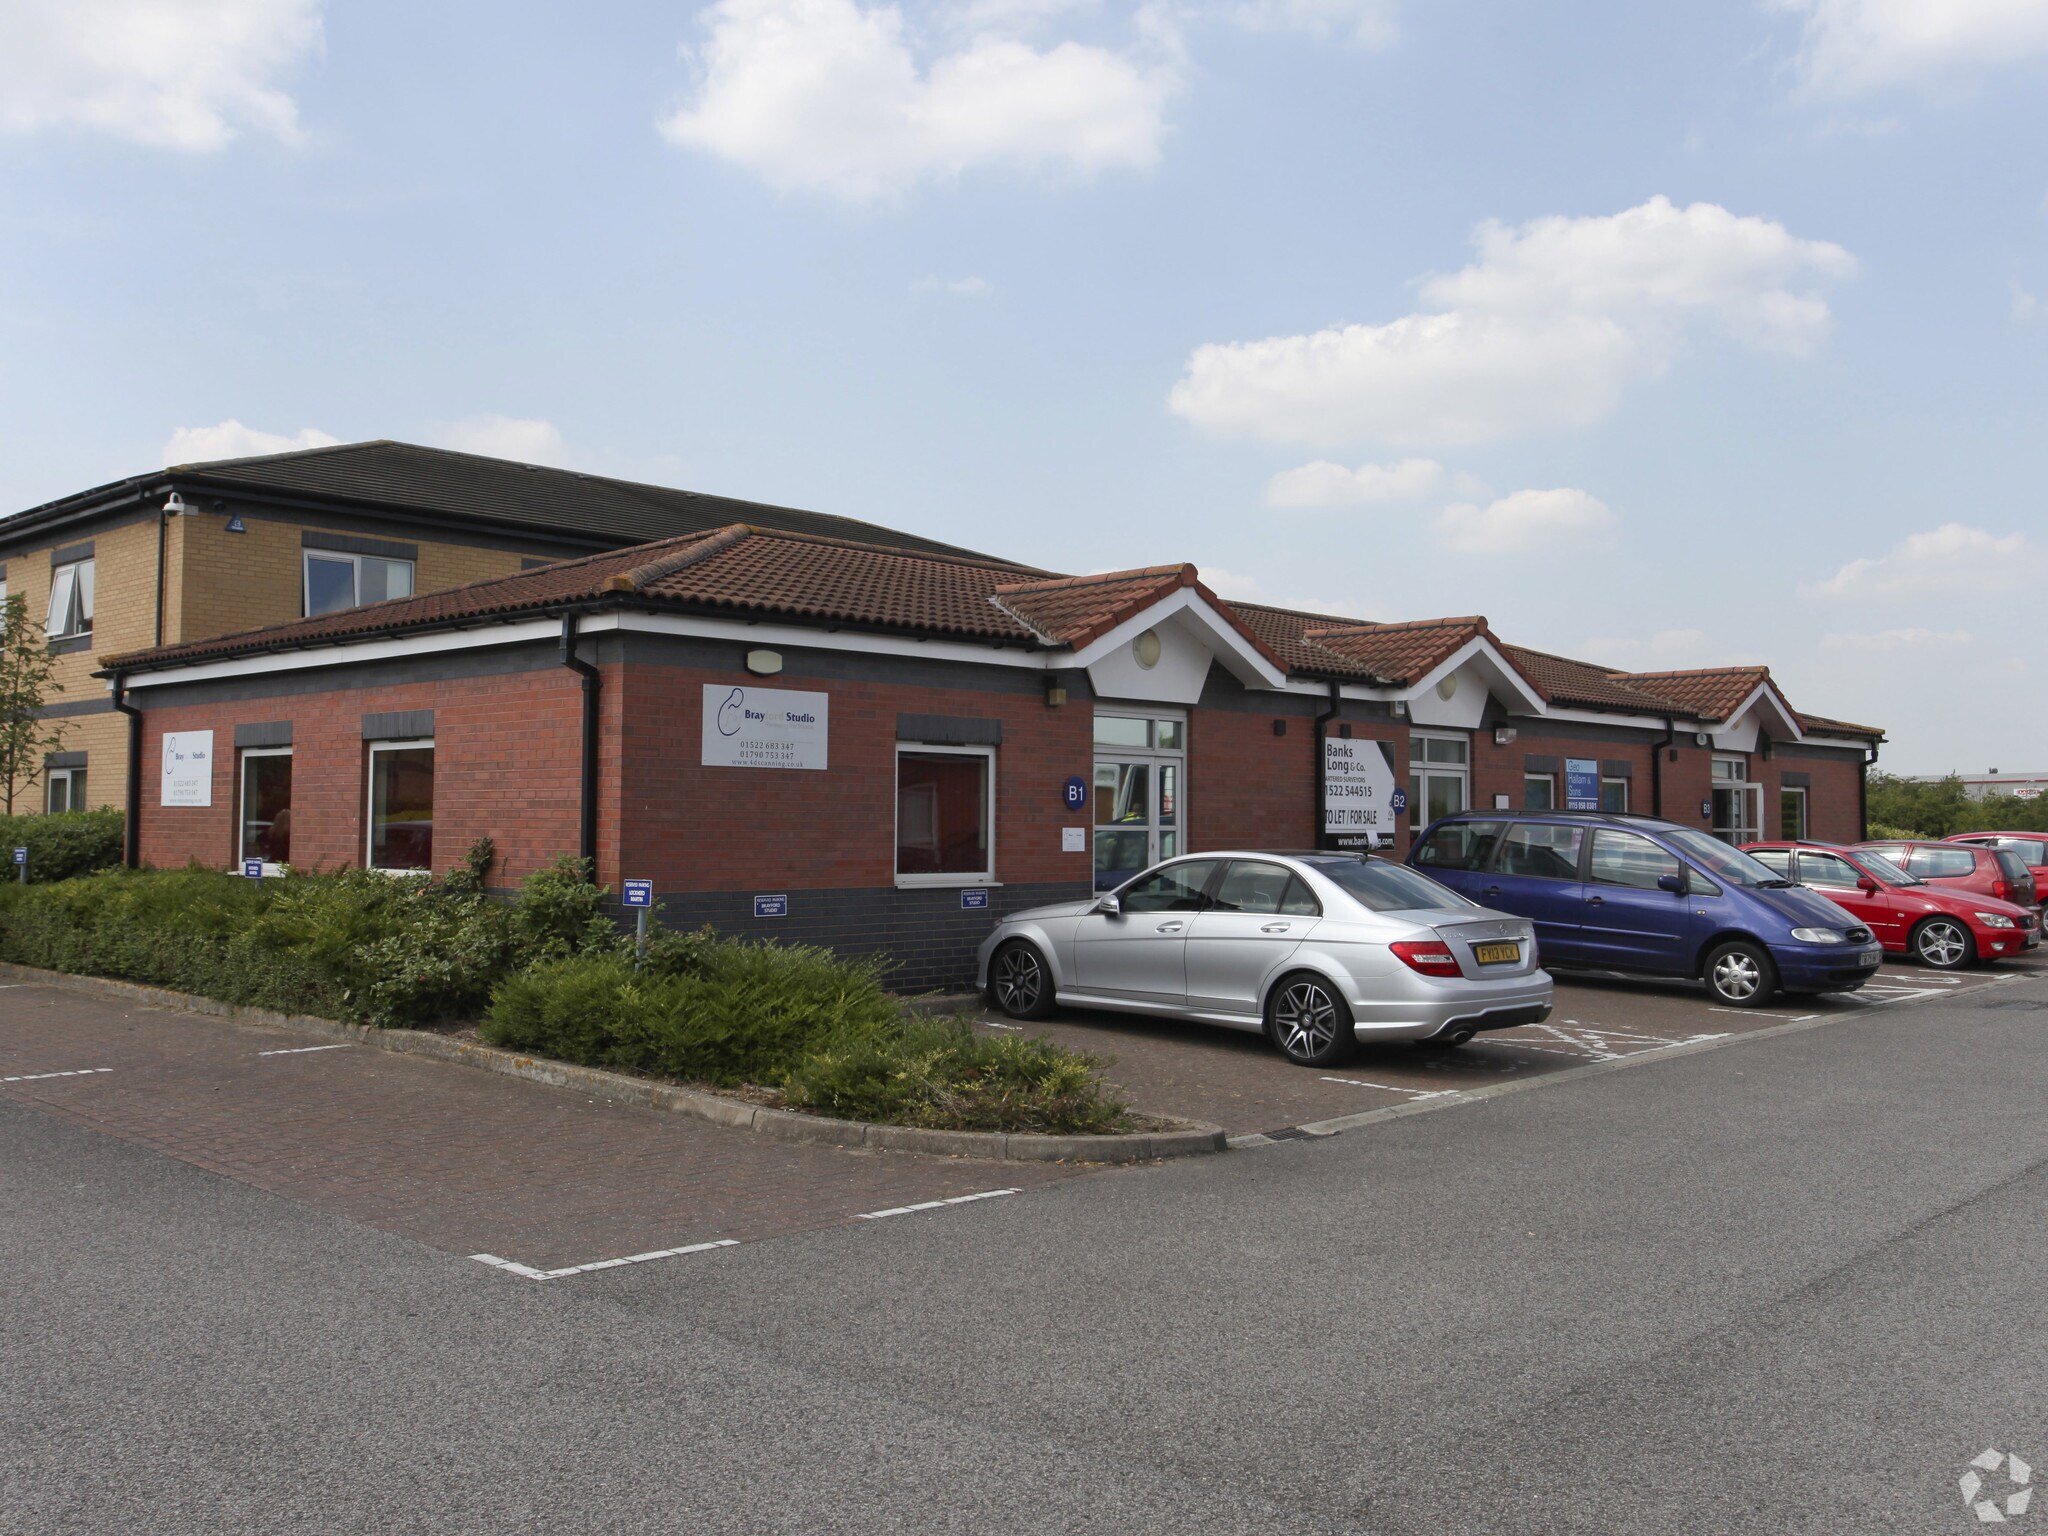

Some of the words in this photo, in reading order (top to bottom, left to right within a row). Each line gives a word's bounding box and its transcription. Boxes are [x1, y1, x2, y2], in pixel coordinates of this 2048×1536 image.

[786, 712, 815, 723] Studio
[740, 741, 764, 749] 01522
[765, 742, 779, 750] 683
[1327, 744, 1353, 758] Banks
[192, 752, 206, 760] Studio
[740, 750, 764, 758] 01790
[765, 751, 779, 759] 753
[781, 752, 795, 760] 347
[732, 760, 804, 768] www.4dscanning.co.uk
[1327, 758, 1349, 774] Long
[1350, 762, 1355, 771] &
[1356, 763, 1366, 772] Co.
[1568, 761, 1580, 771] Geo
[1568, 773, 1587, 784] Hallam
[1069, 785, 1083, 801] B1
[1325, 785, 1344, 796] 1522
[1346, 786, 1372, 797] 544515
[1568, 785, 1581, 796] Sons
[1394, 795, 1405, 807] B2
[1703, 803, 1710, 813] B3
[1334, 810, 1346, 824] LET
[1350, 810, 1363, 824] FOR
[1363, 810, 1377, 824] SALE
[1482, 947, 1500, 960] FY13
[1501, 946, 1514, 959] YCK
